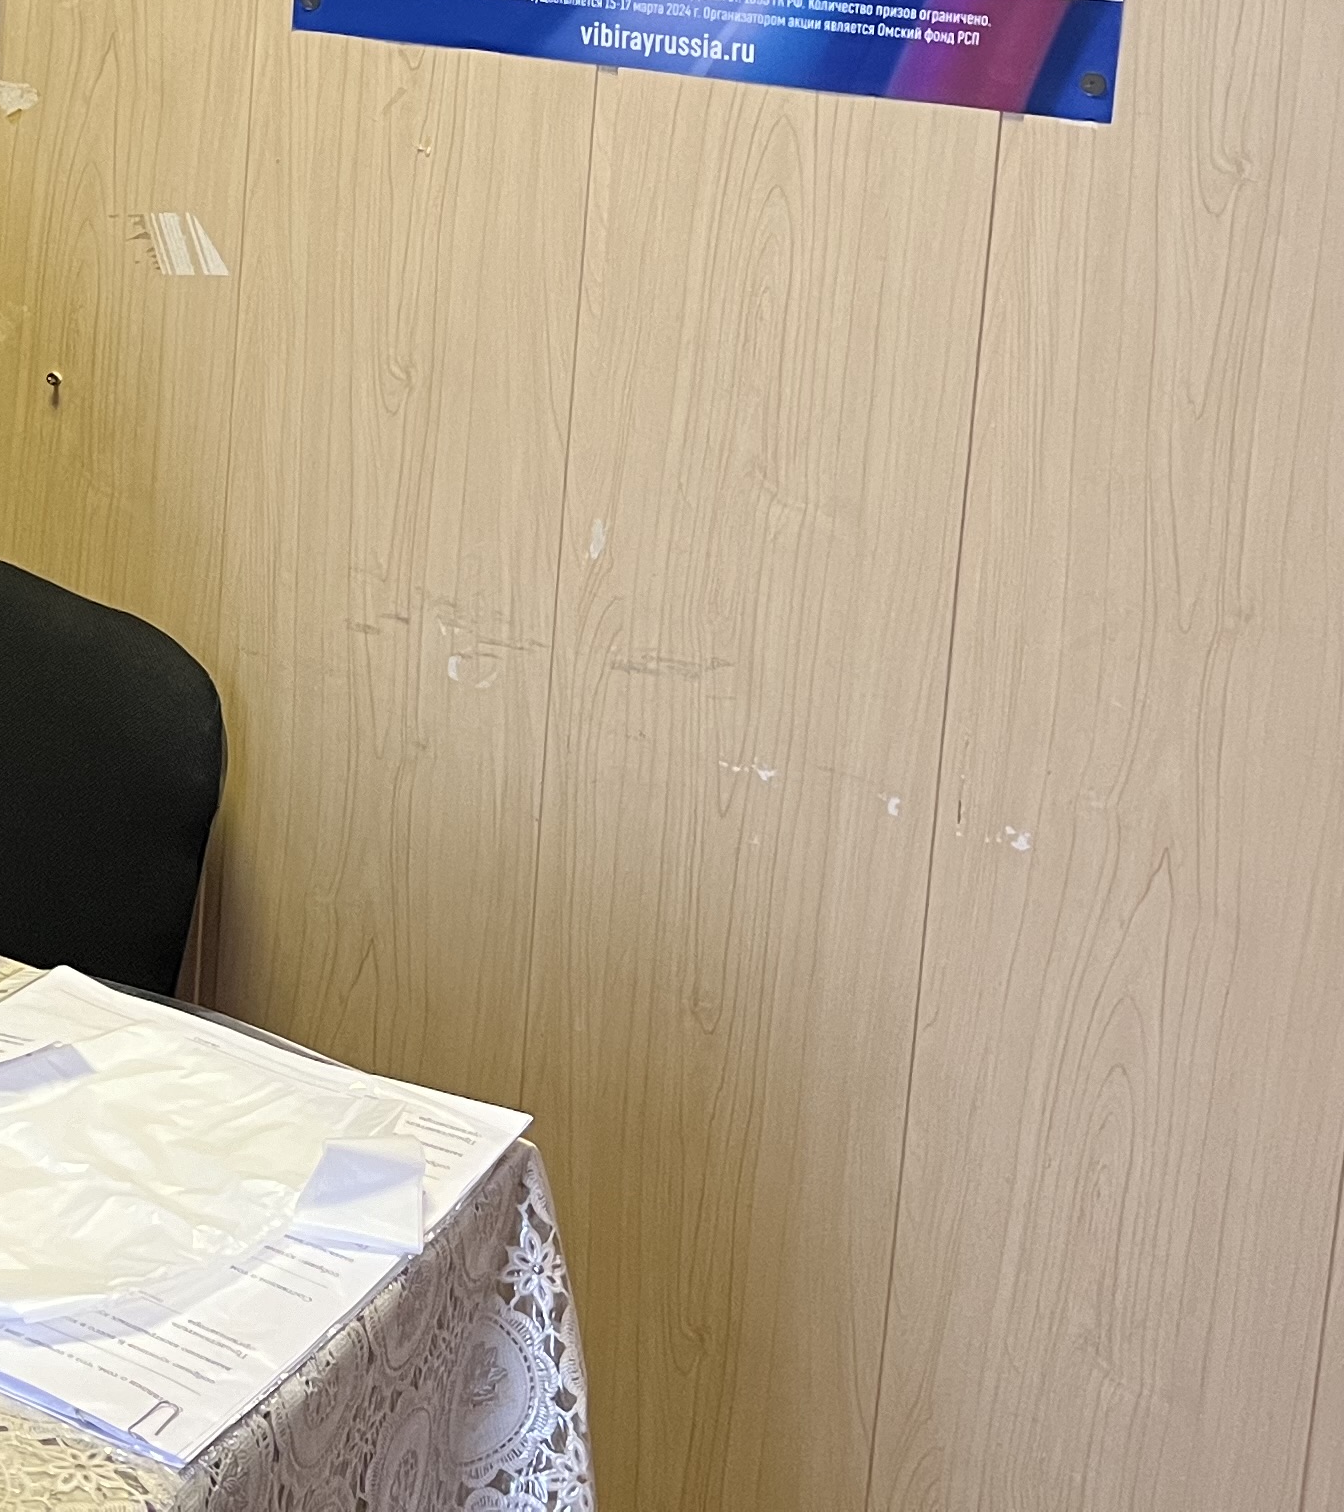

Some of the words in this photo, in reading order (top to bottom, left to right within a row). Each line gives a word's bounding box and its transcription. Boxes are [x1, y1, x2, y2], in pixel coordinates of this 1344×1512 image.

[633, 2, 663, 16] марта
[666, 3, 691, 17] 2024
[703, 5, 786, 28] Организатором
[788, 16, 821, 31] акции
[824, 20, 874, 36] является
[877, 23, 921, 41] Омский
[924, 27, 954, 46] фонд
[957, 31, 979, 46] РСП
[875, 5, 916, 22] призов
[919, 9, 991, 28] ограничено.
[580, 21, 755, 63] vibirayrussia.ru
